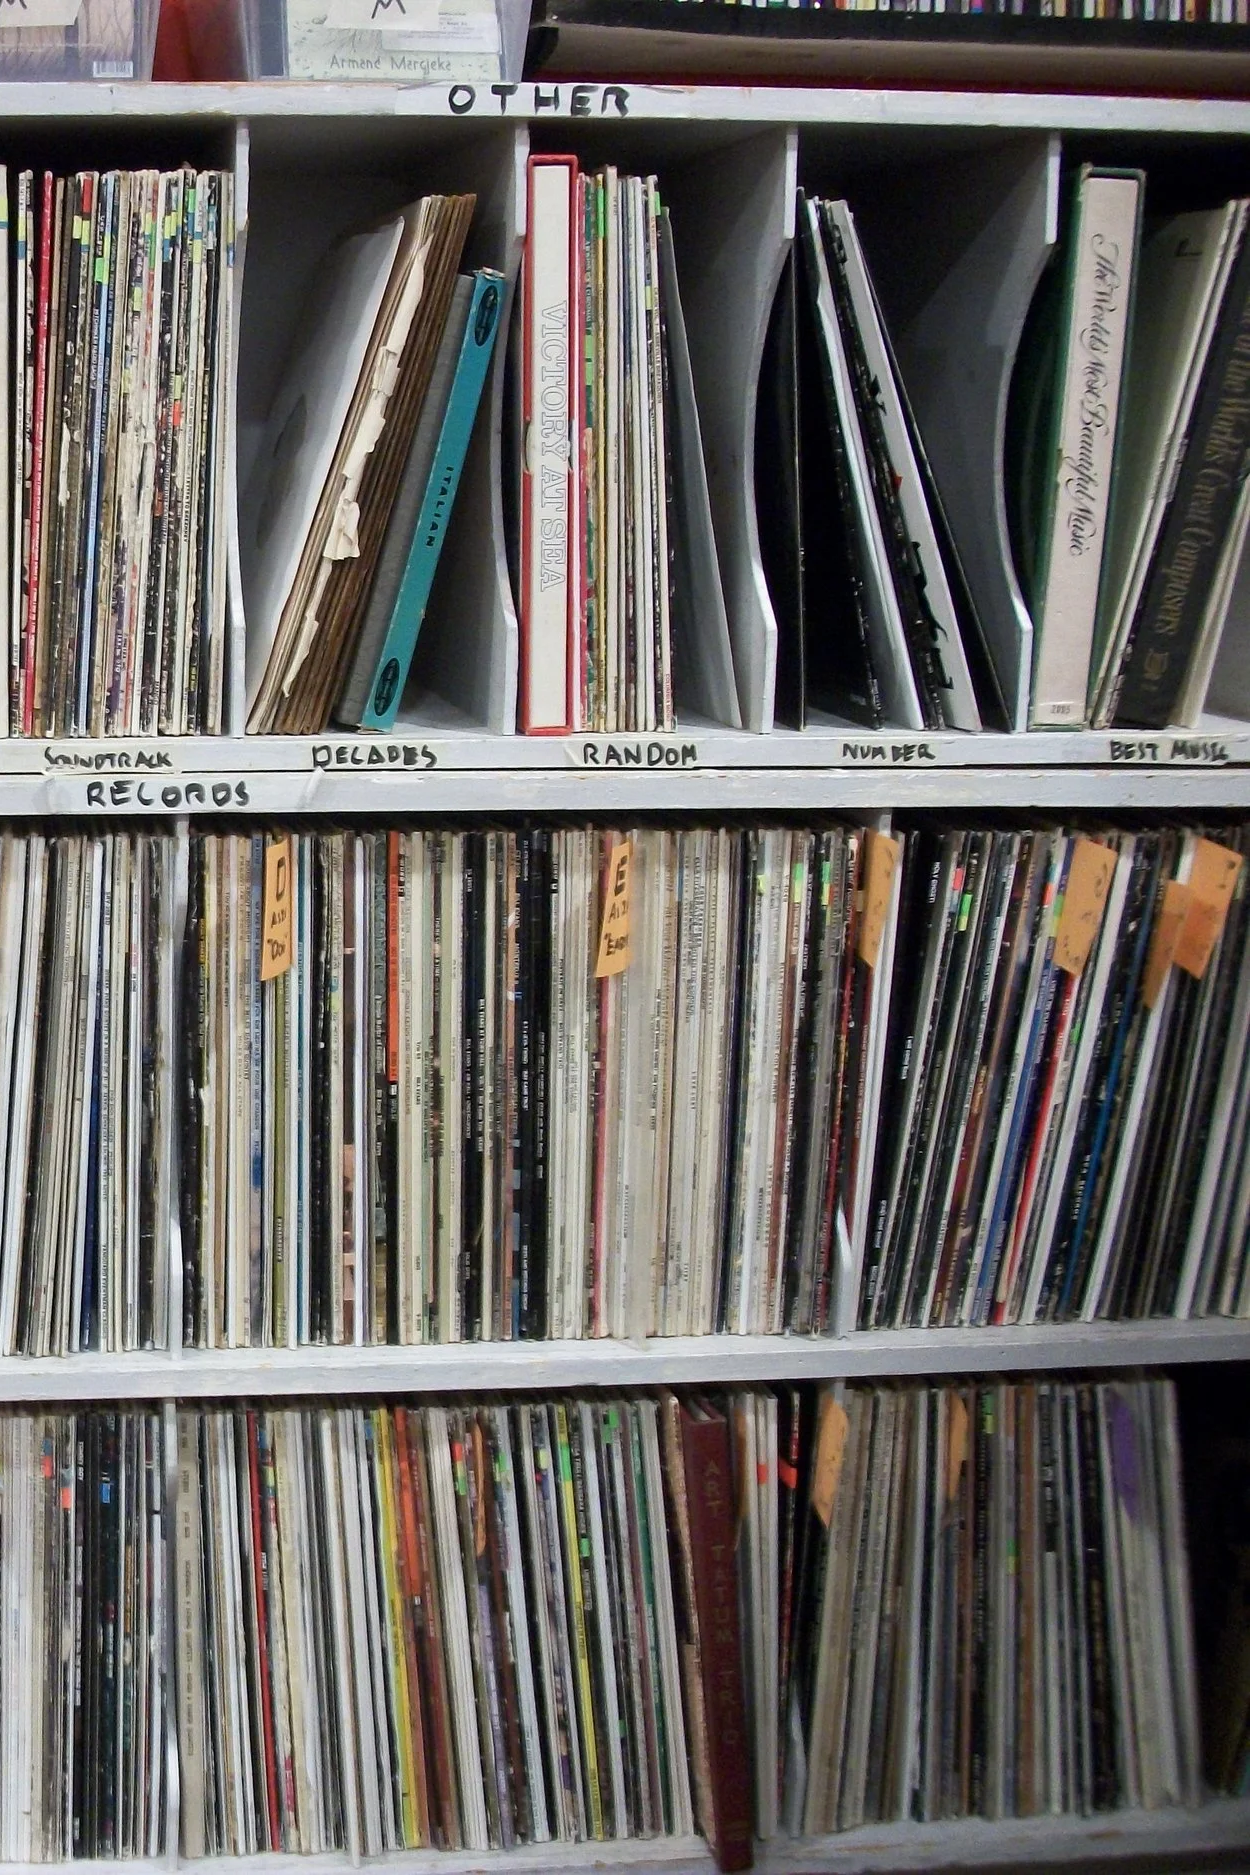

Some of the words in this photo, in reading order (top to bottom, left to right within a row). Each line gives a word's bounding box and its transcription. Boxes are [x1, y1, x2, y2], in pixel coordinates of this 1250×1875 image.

[448, 84, 630, 117] OTHER
[1091, 234, 1120, 288] The
[540, 301, 567, 468] VICTORY
[1083, 356, 1109, 399] Most
[1062, 399, 1110, 502] Beautiful
[1201, 398, 1249, 463] World's
[424, 465, 453, 549] ITALIAN
[541, 467, 567, 509] AT
[1186, 465, 1229, 526] Great
[541, 517, 567, 592] SEA
[1068, 501, 1097, 557] Music
[1155, 526, 1216, 636] Composers
[312, 744, 438, 768] DECADES
[582, 742, 698, 766] RANDOM
[842, 742, 936, 762] NUMBER
[1109, 740, 1158, 761] BEST
[86, 779, 251, 809] RECORDS
[931, 862, 940, 878] HOLY
[703, 1459, 723, 1520] ART
[710, 1545, 732, 1645] TATUM
[716, 1669, 739, 1747] TRIO
